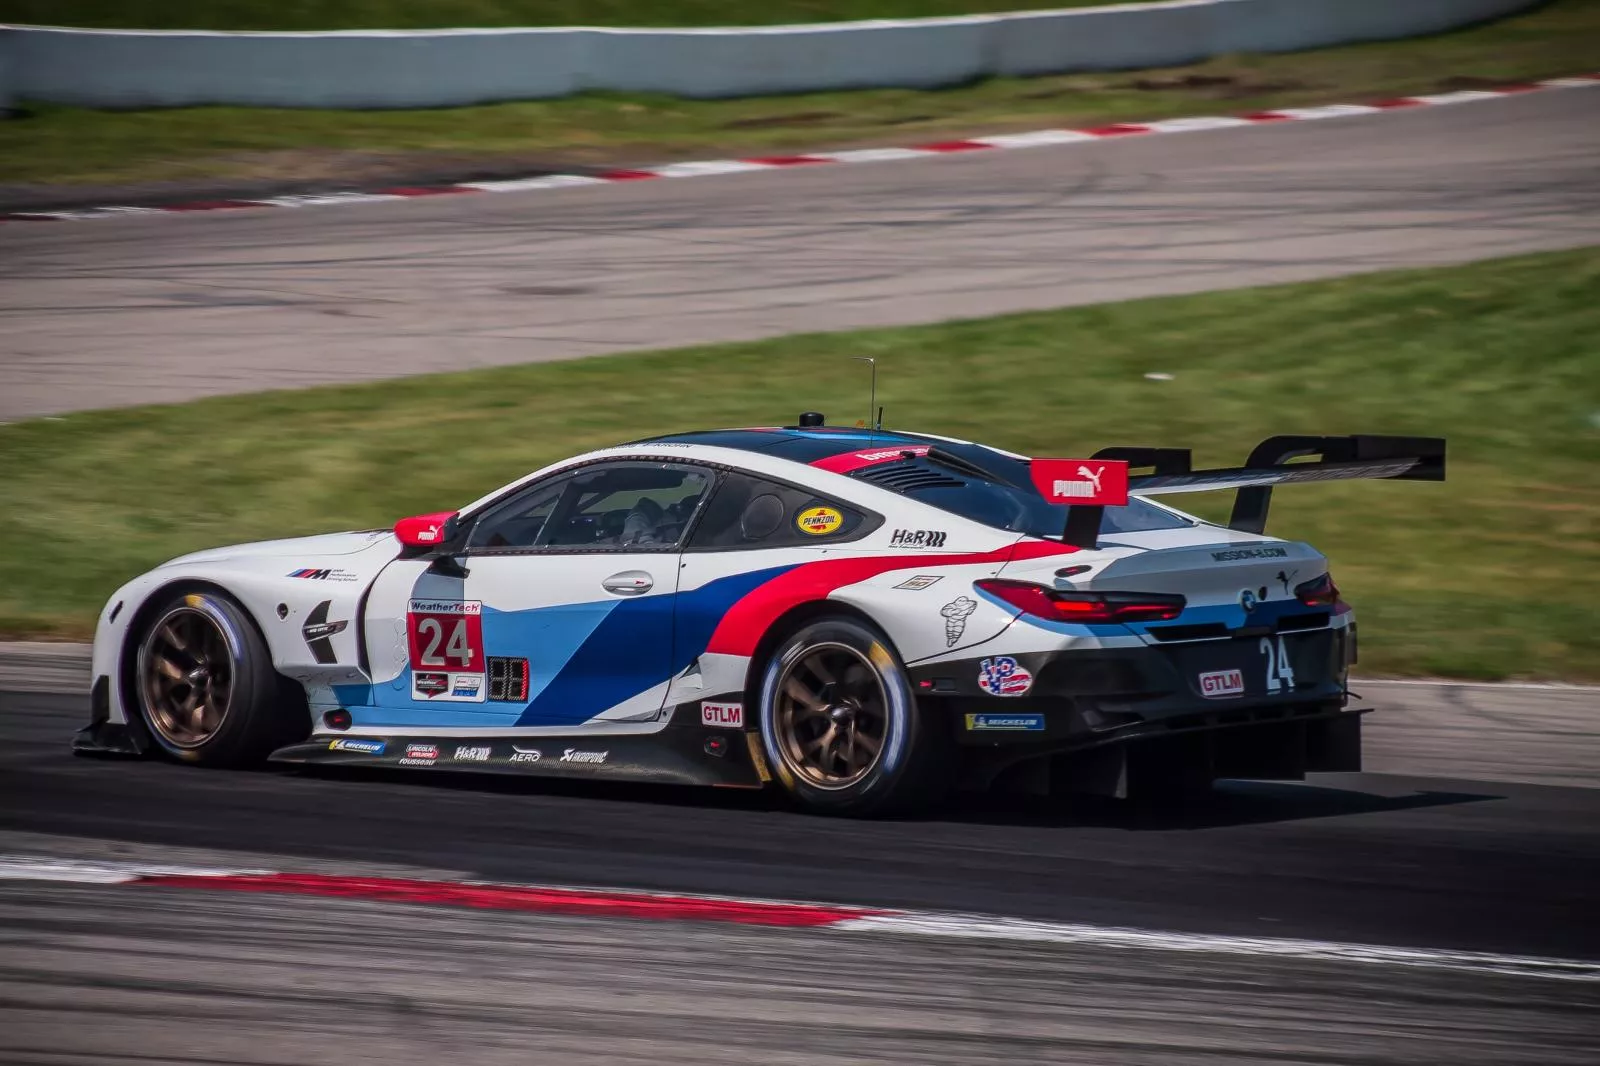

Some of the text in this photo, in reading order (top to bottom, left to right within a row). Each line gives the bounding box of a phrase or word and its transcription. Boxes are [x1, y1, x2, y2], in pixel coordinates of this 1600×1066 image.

[803, 515, 837, 526] PENNZOIL
[891, 529, 925, 546] H&R
[411, 601, 479, 612] WeatherTech
[418, 617, 474, 667] 24
[1260, 635, 1295, 690] 24
[1203, 673, 1241, 692] GTLM
[703, 705, 741, 723] GTLM
[345, 742, 381, 751] MICHELIN
[509, 753, 541, 762] AERO
